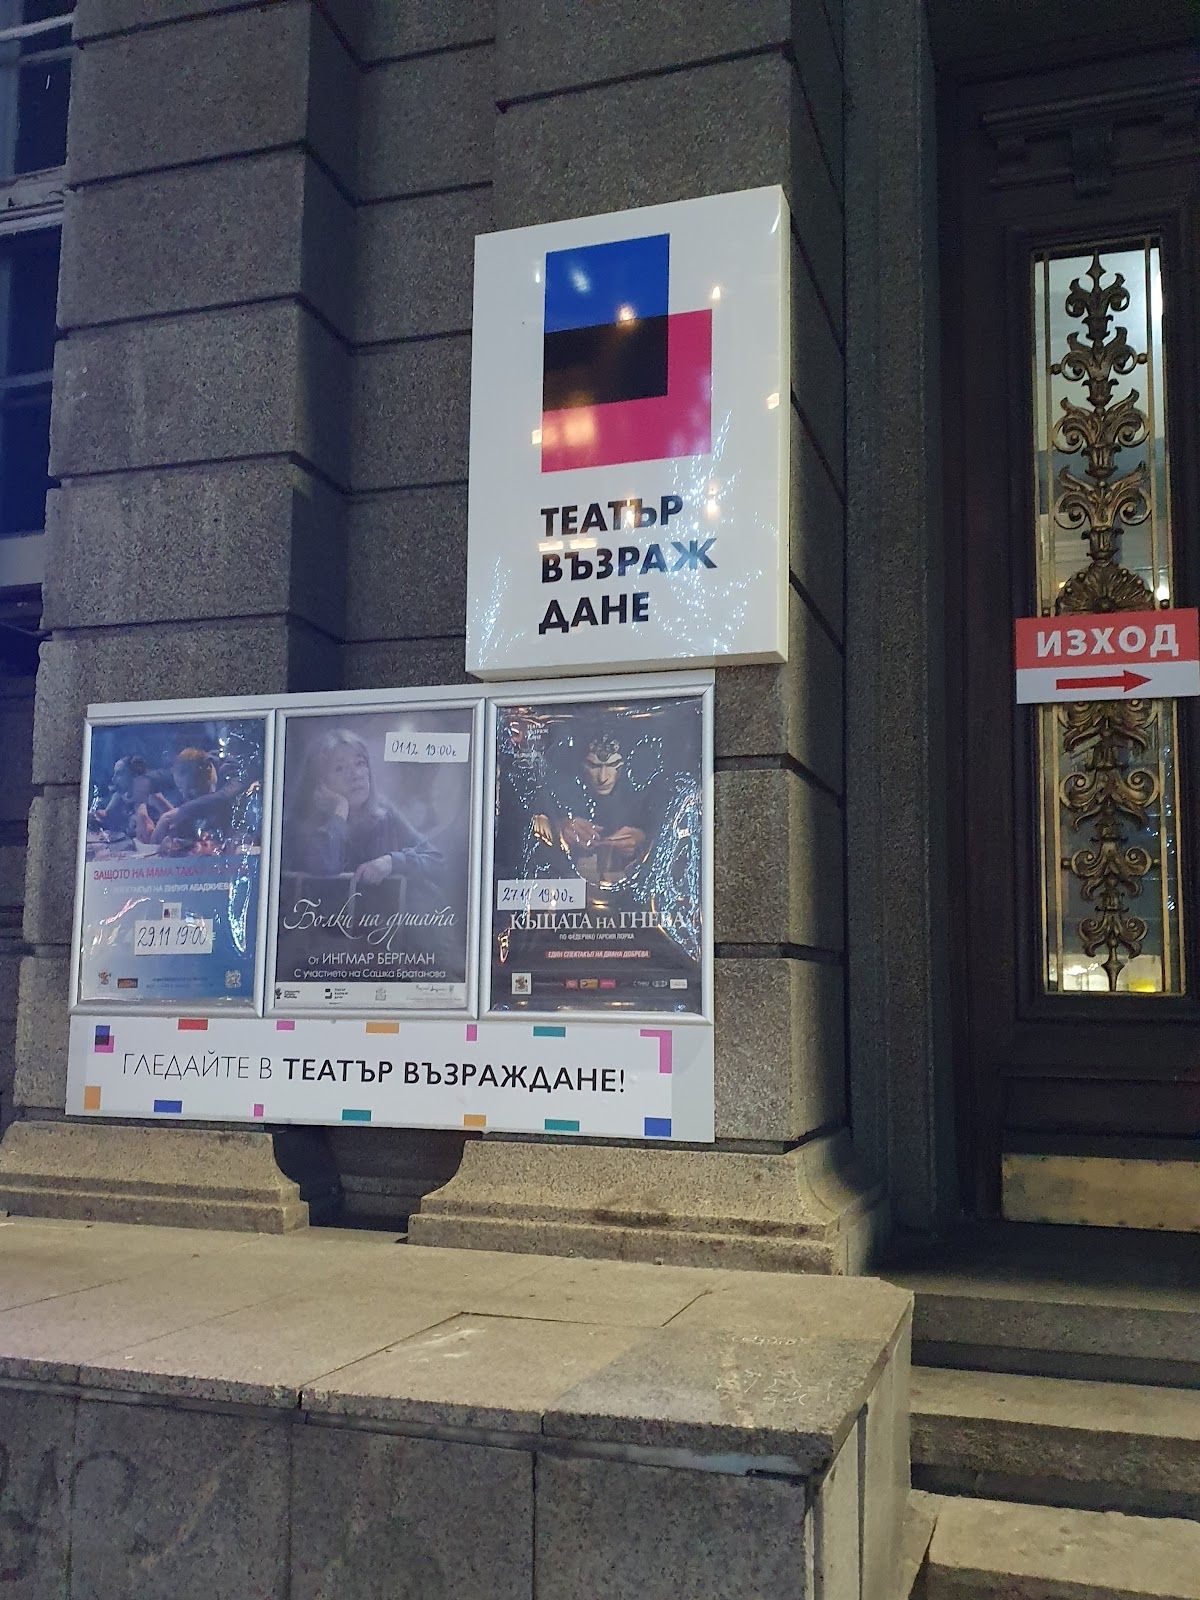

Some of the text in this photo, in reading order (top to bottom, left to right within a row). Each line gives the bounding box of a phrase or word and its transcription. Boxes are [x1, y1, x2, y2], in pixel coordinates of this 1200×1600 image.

[541, 495, 683, 537] ТЕАТЪР
[542, 538, 717, 583] ВЪЗРАЖ
[539, 592, 649, 635] ДАНЕ
[1037, 624, 1179, 658] ИЗХОД
[93, 869, 130, 881] ЗАЩОТО
[358, 913, 379, 928] на
[367, 905, 457, 952] душата
[510, 910, 593, 932] КЪЩАТА
[322, 952, 375, 965] ИНГМАР
[377, 952, 435, 965] БЕРГМАН
[362, 969, 395, 978] Сашка
[123, 1050, 625, 1093] ГЛЕДАЙТЕ В ТЕАТЪР ВЪЗРАЖДАНЕ!
